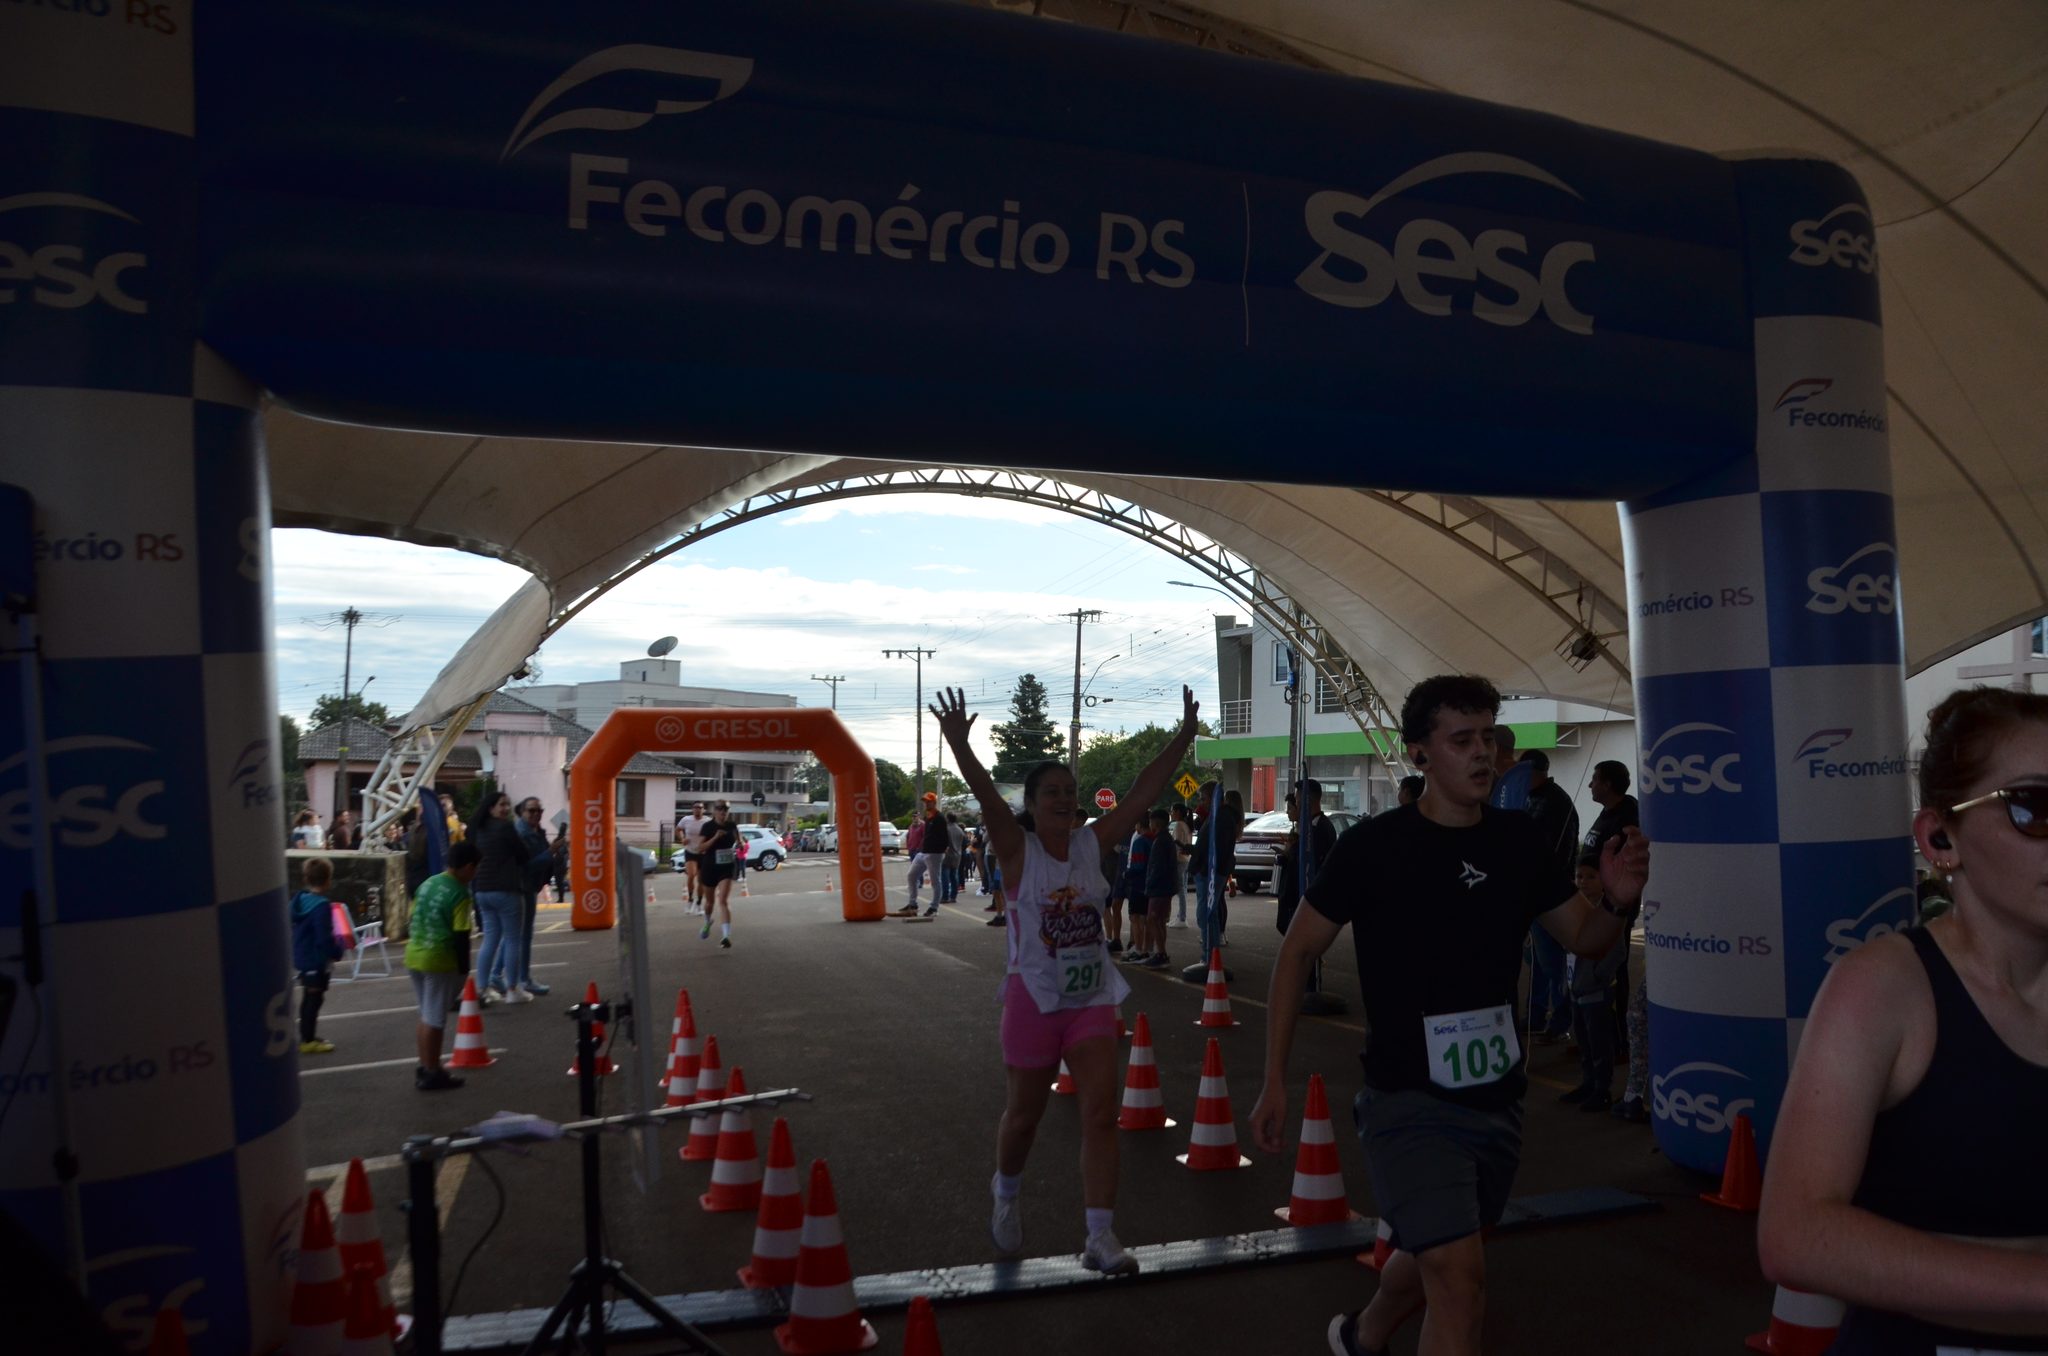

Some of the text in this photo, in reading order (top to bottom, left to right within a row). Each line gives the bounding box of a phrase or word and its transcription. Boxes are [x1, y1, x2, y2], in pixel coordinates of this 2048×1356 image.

[567, 152, 1196, 288] Fecomércio RS
[1294, 190, 1596, 336] Sesc
[136, 533, 183, 562] RS
[1721, 587, 1754, 606] RS
[693, 718, 798, 740] CRESOL
[585, 792, 604, 882] CRESOL
[854, 785, 874, 873] CRESOL
[1738, 936, 1772, 956] RS
[1065, 961, 1102, 993] 297
[169, 1041, 214, 1073] RS
[1443, 1035, 1510, 1082] 103
